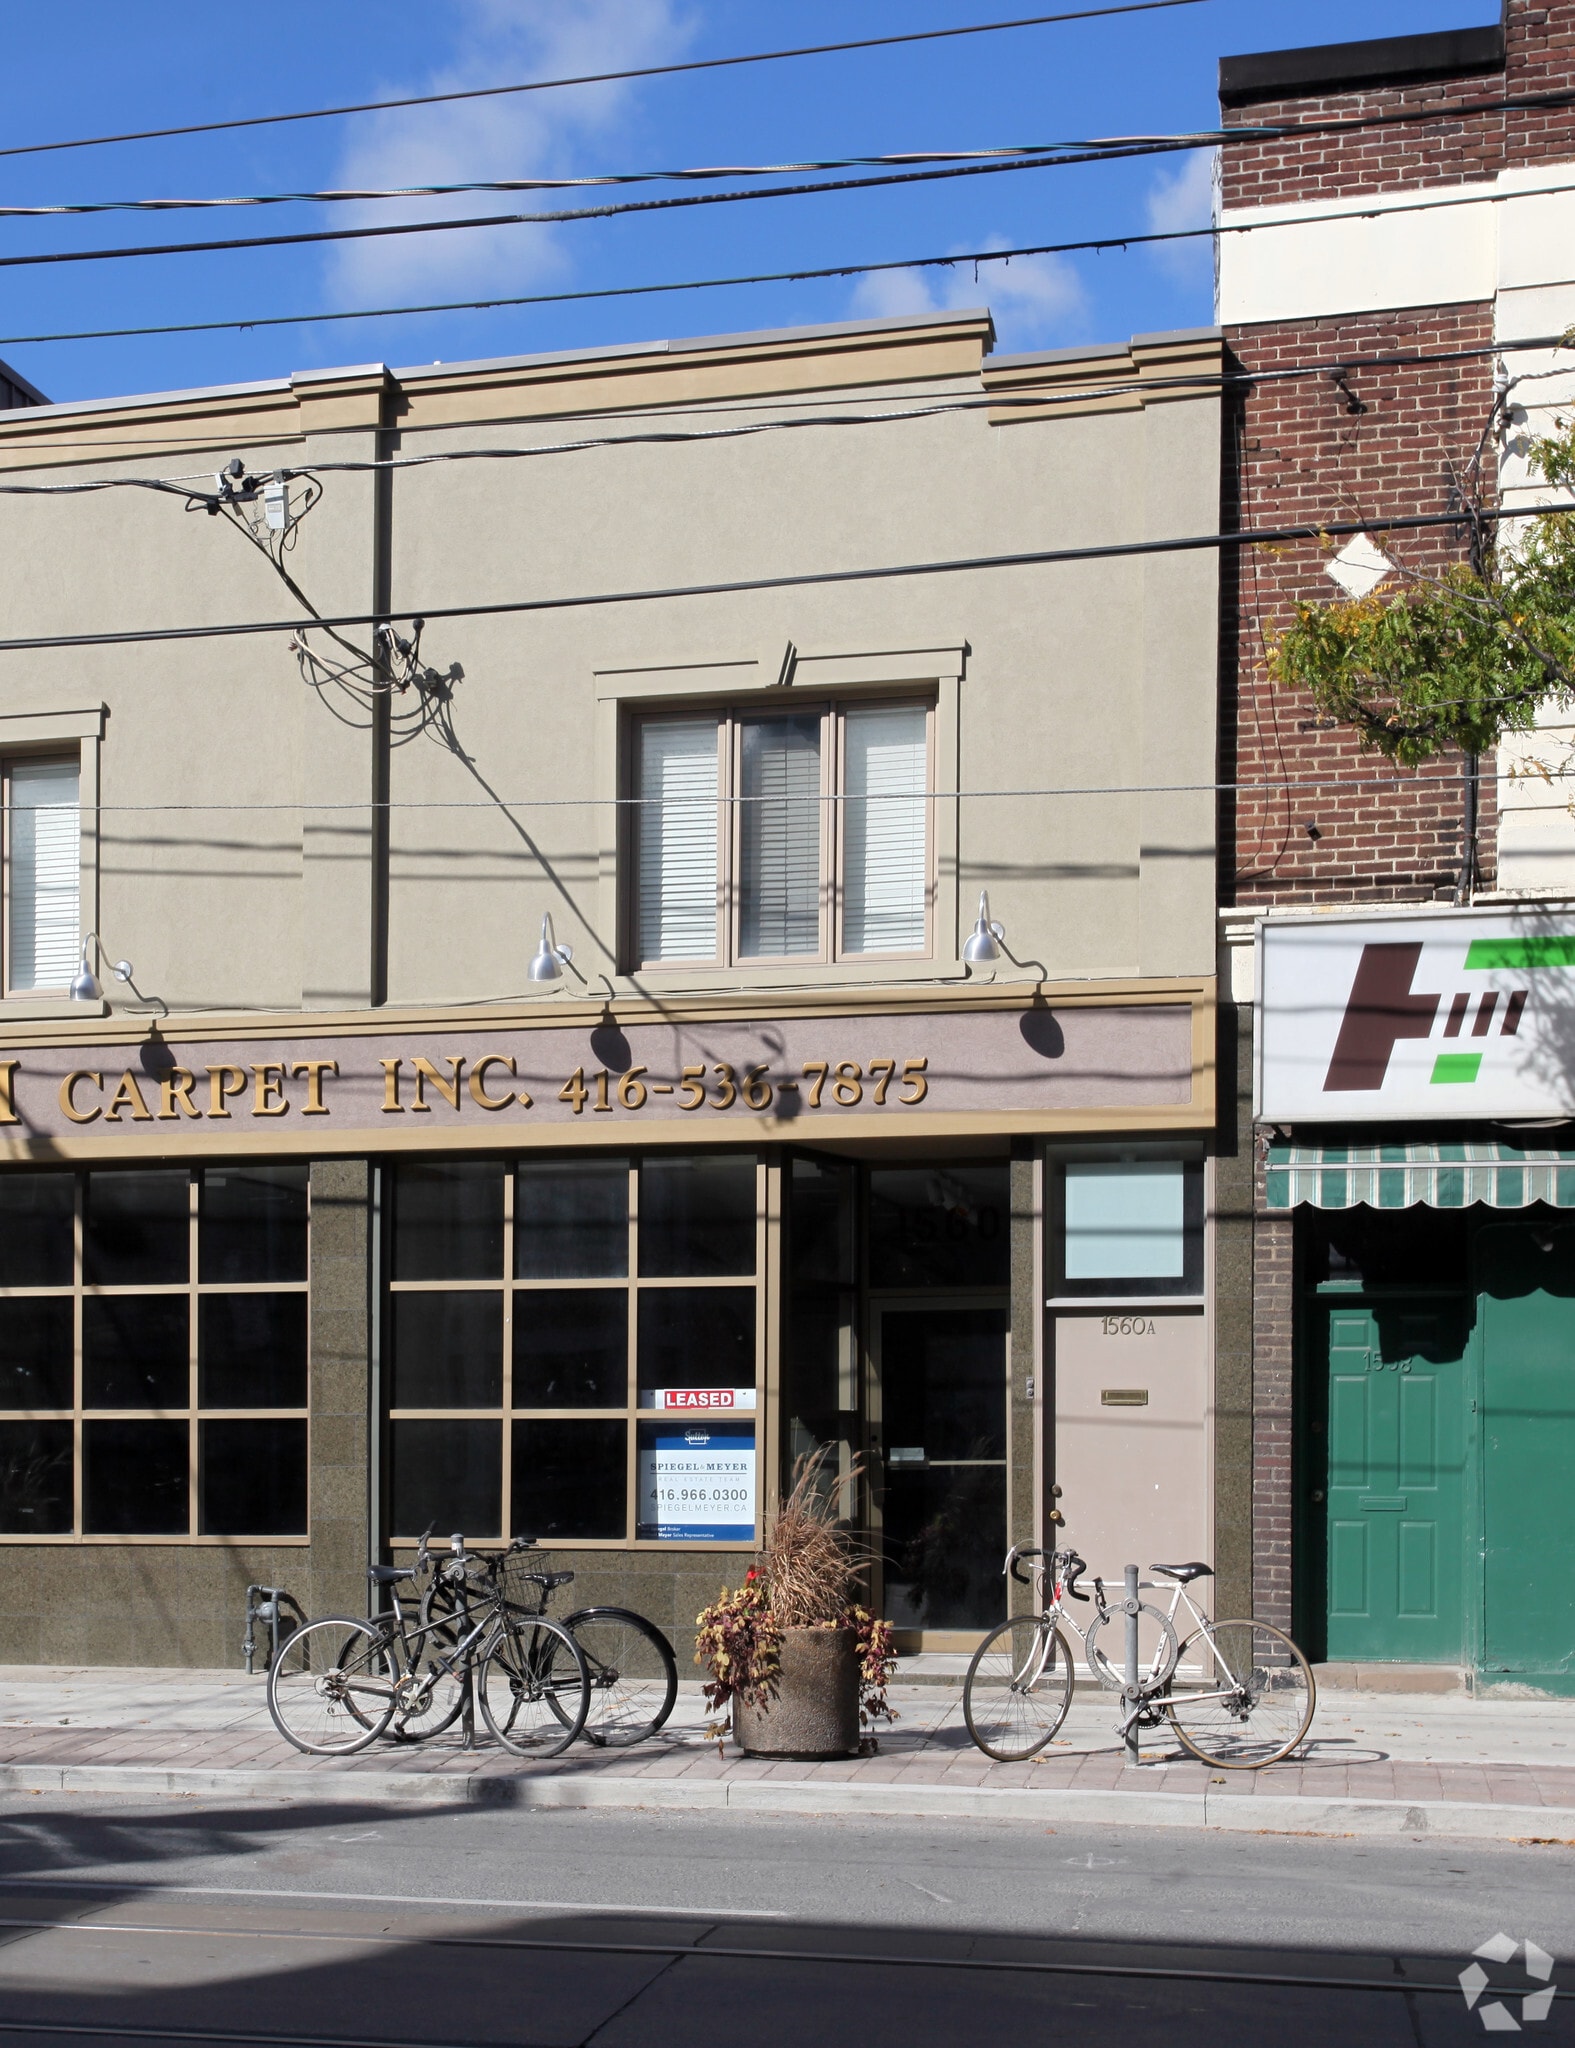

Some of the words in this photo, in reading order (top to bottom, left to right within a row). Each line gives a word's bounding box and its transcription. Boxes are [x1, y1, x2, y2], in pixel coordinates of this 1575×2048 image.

[57, 1060, 340, 1124] CARPET
[379, 1054, 534, 1114] INC.
[557, 1057, 929, 1115] 416-536-7875
[1101, 1316, 1156, 1335] 1560A
[666, 1392, 732, 1407] LEASED
[650, 1463, 700, 1471] SPIEGEL
[706, 1463, 748, 1471] MEYER
[650, 1489, 748, 1501] 416.966.0300
[650, 1504, 747, 1512] SPIEGELMEYER.CA
